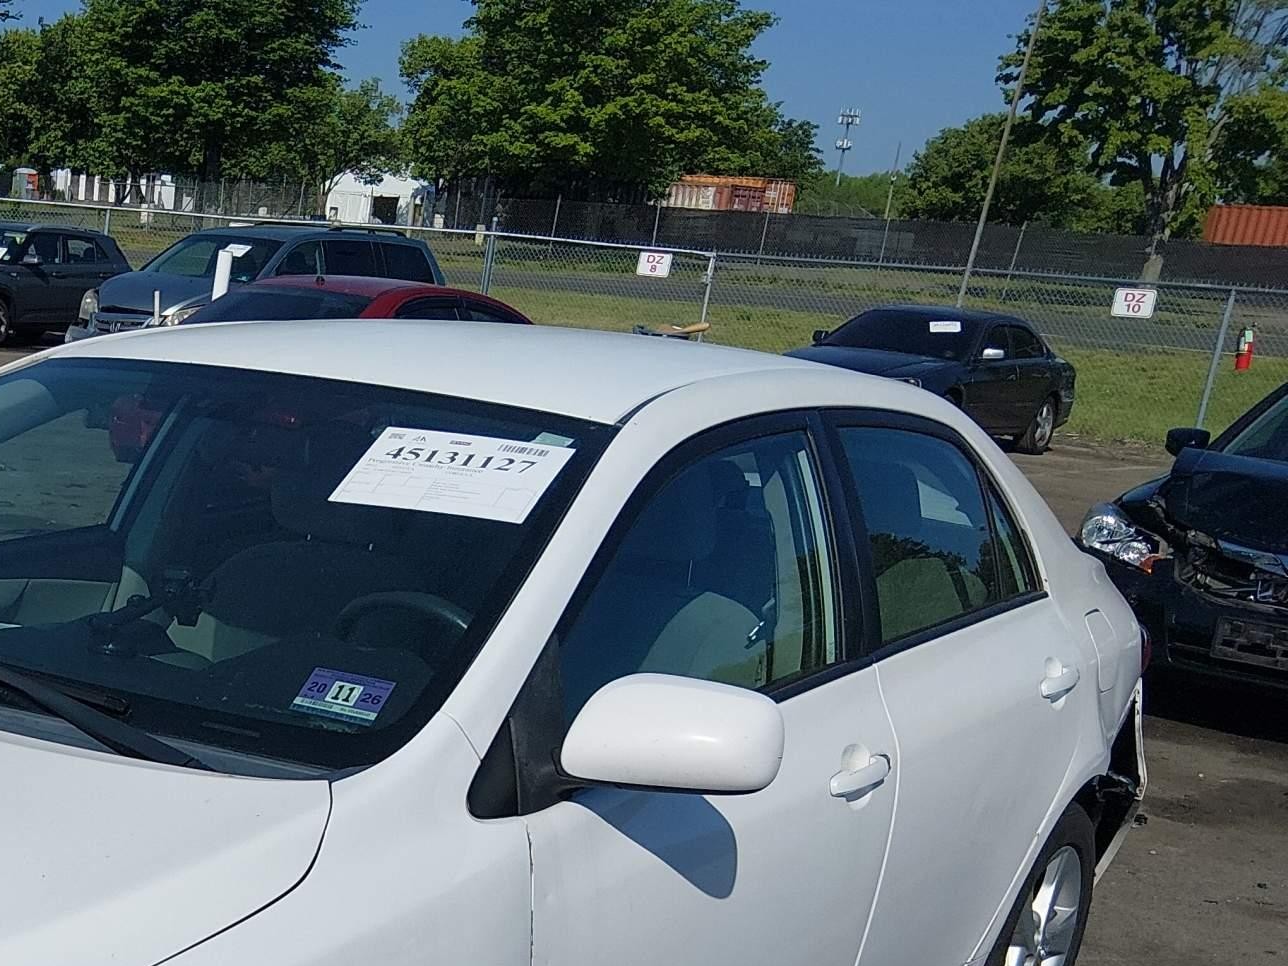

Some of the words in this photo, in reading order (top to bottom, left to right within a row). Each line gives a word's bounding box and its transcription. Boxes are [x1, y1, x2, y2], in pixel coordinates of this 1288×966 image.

[647, 255, 665, 264] DZ
[650, 264, 657, 273] 8
[1124, 293, 1146, 303] DZ
[1125, 304, 1141, 313] 10
[385, 446, 538, 474] 45131127
[307, 681, 328, 694] 20
[330, 684, 356, 703] 11
[359, 693, 383, 705] 26
